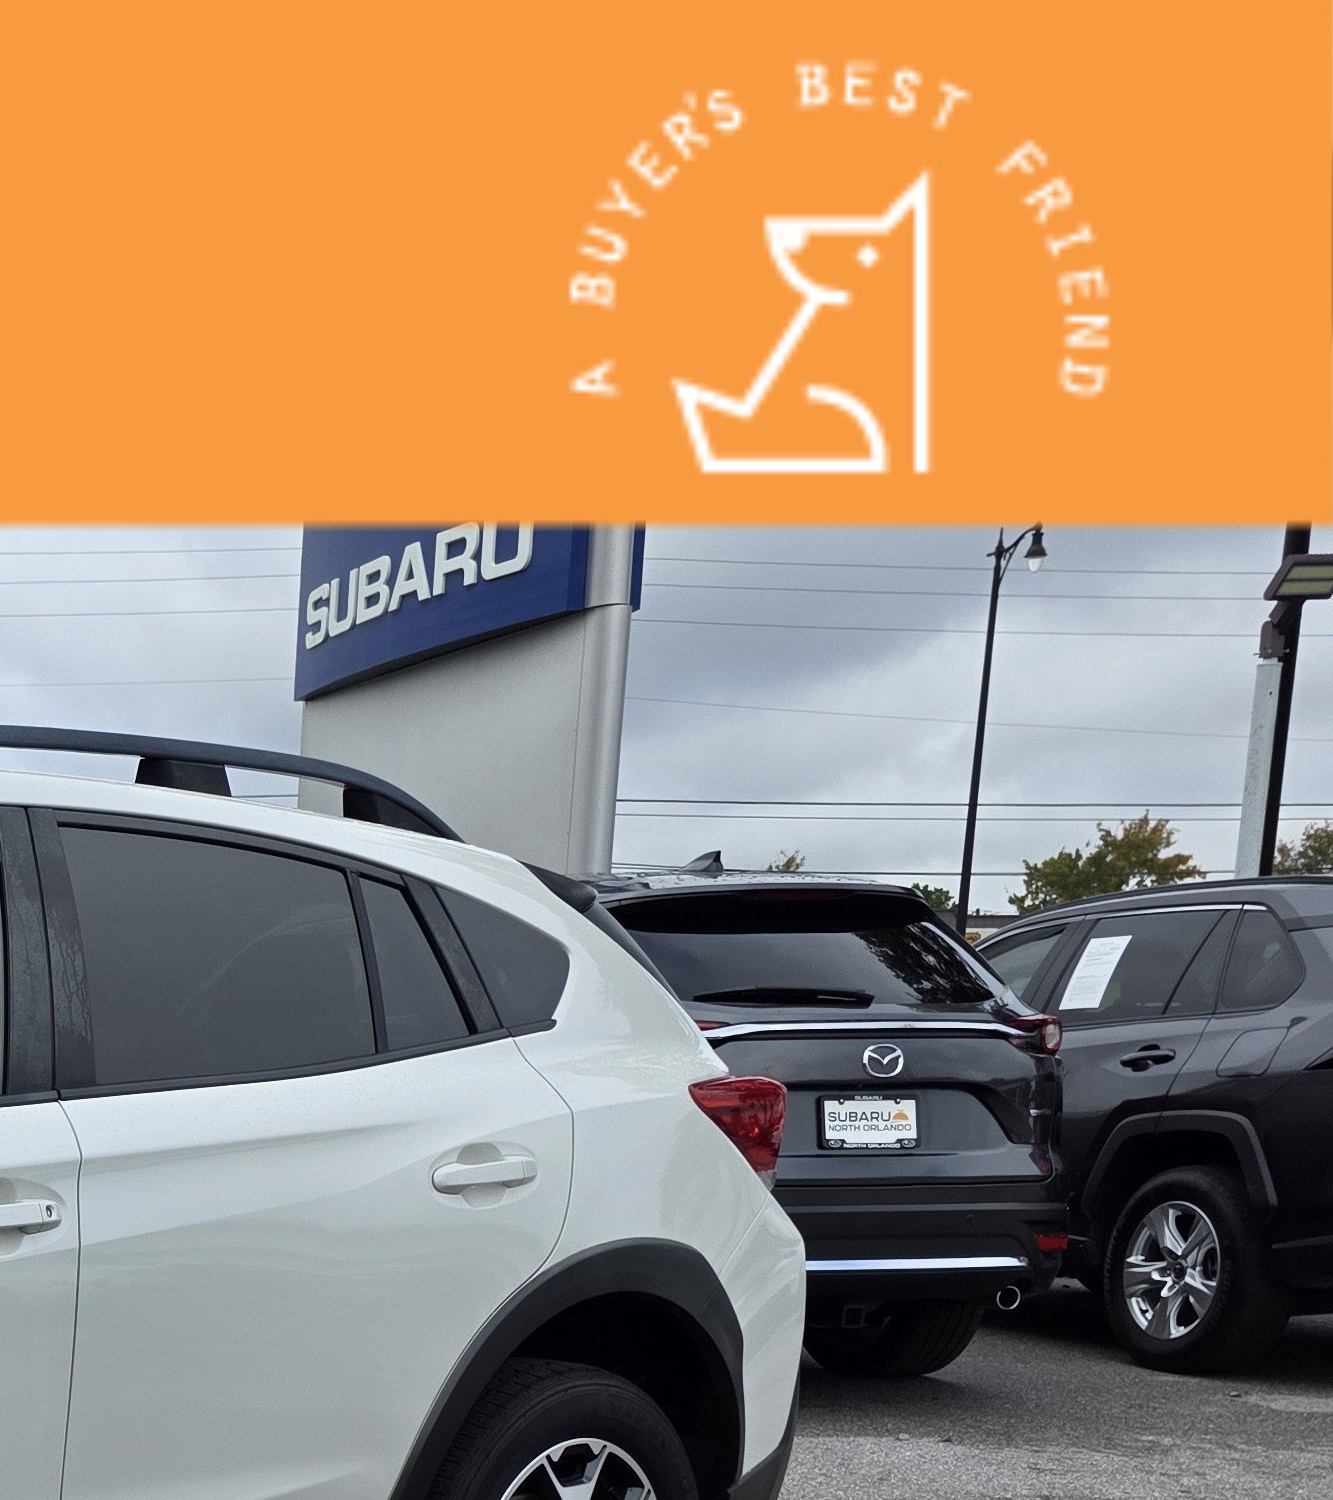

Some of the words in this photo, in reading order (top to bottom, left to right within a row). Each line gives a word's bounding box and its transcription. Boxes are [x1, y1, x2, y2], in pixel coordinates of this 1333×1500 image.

[305, 523, 533, 650] SUBARU
[828, 1111, 892, 1122] SUBARU
[828, 1124, 861, 1132] NORTH
[862, 1123, 912, 1132] ORLANDO
